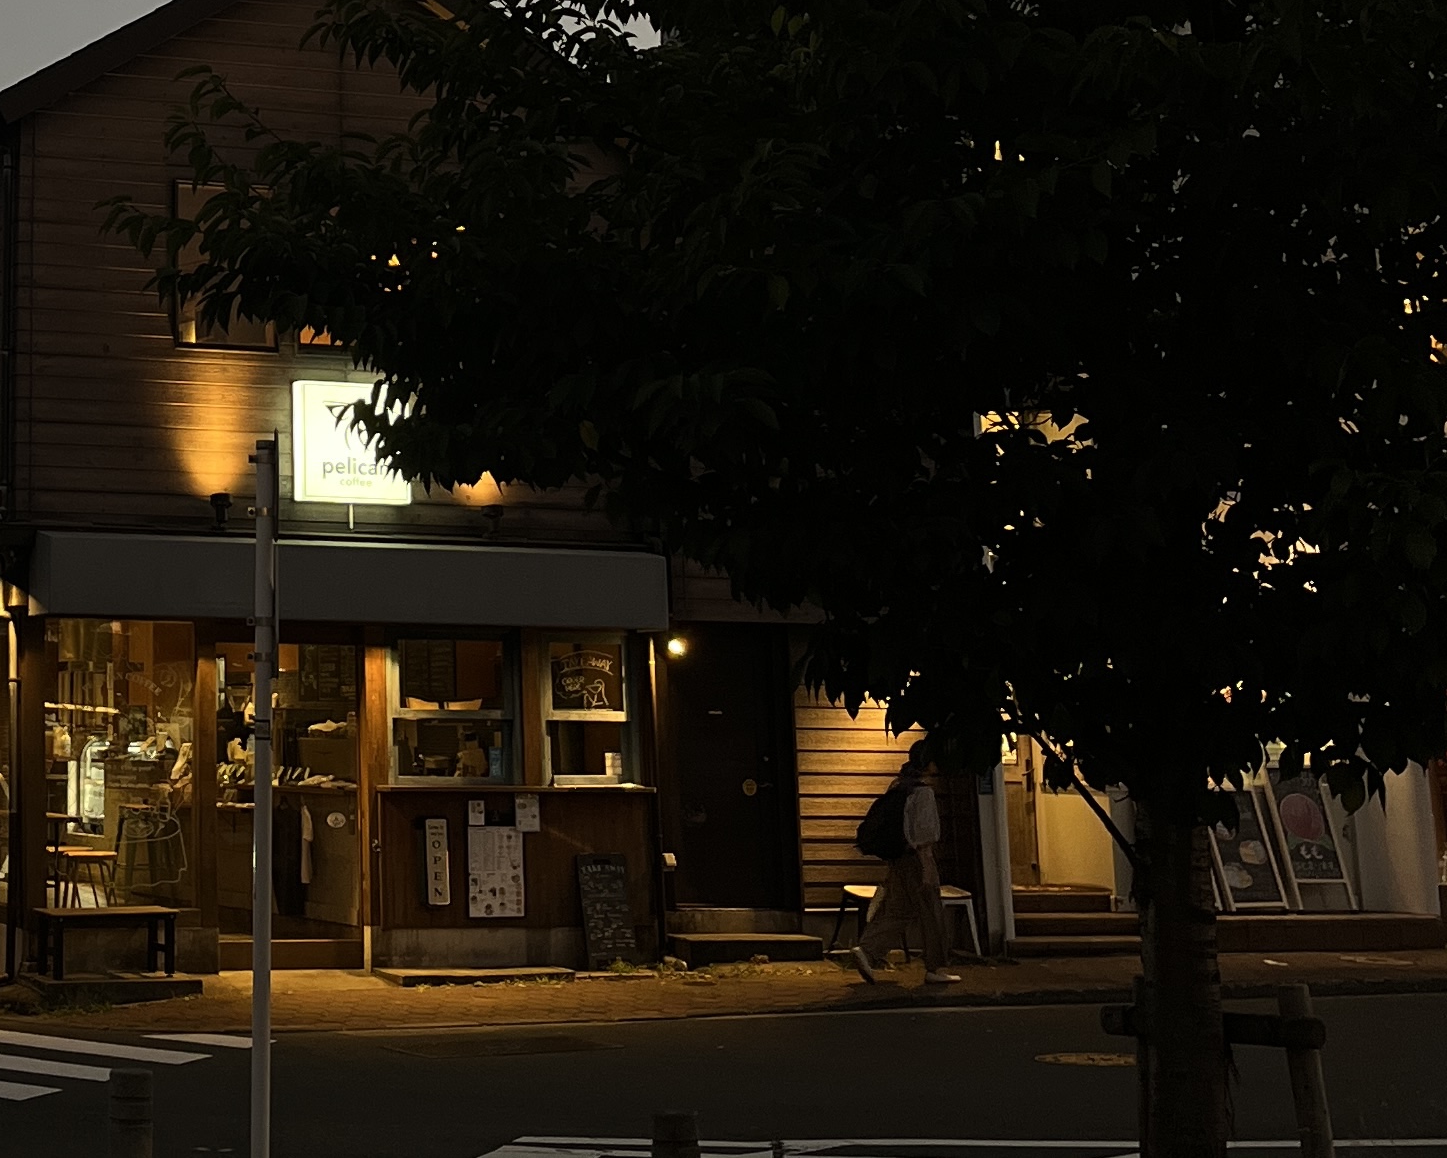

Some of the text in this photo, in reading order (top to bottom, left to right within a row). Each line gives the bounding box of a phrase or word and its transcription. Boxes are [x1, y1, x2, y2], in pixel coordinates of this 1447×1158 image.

[339, 476, 373, 488] coffee
[1299, 843, 1324, 860] もも
[432, 840, 444, 898] OPEN
